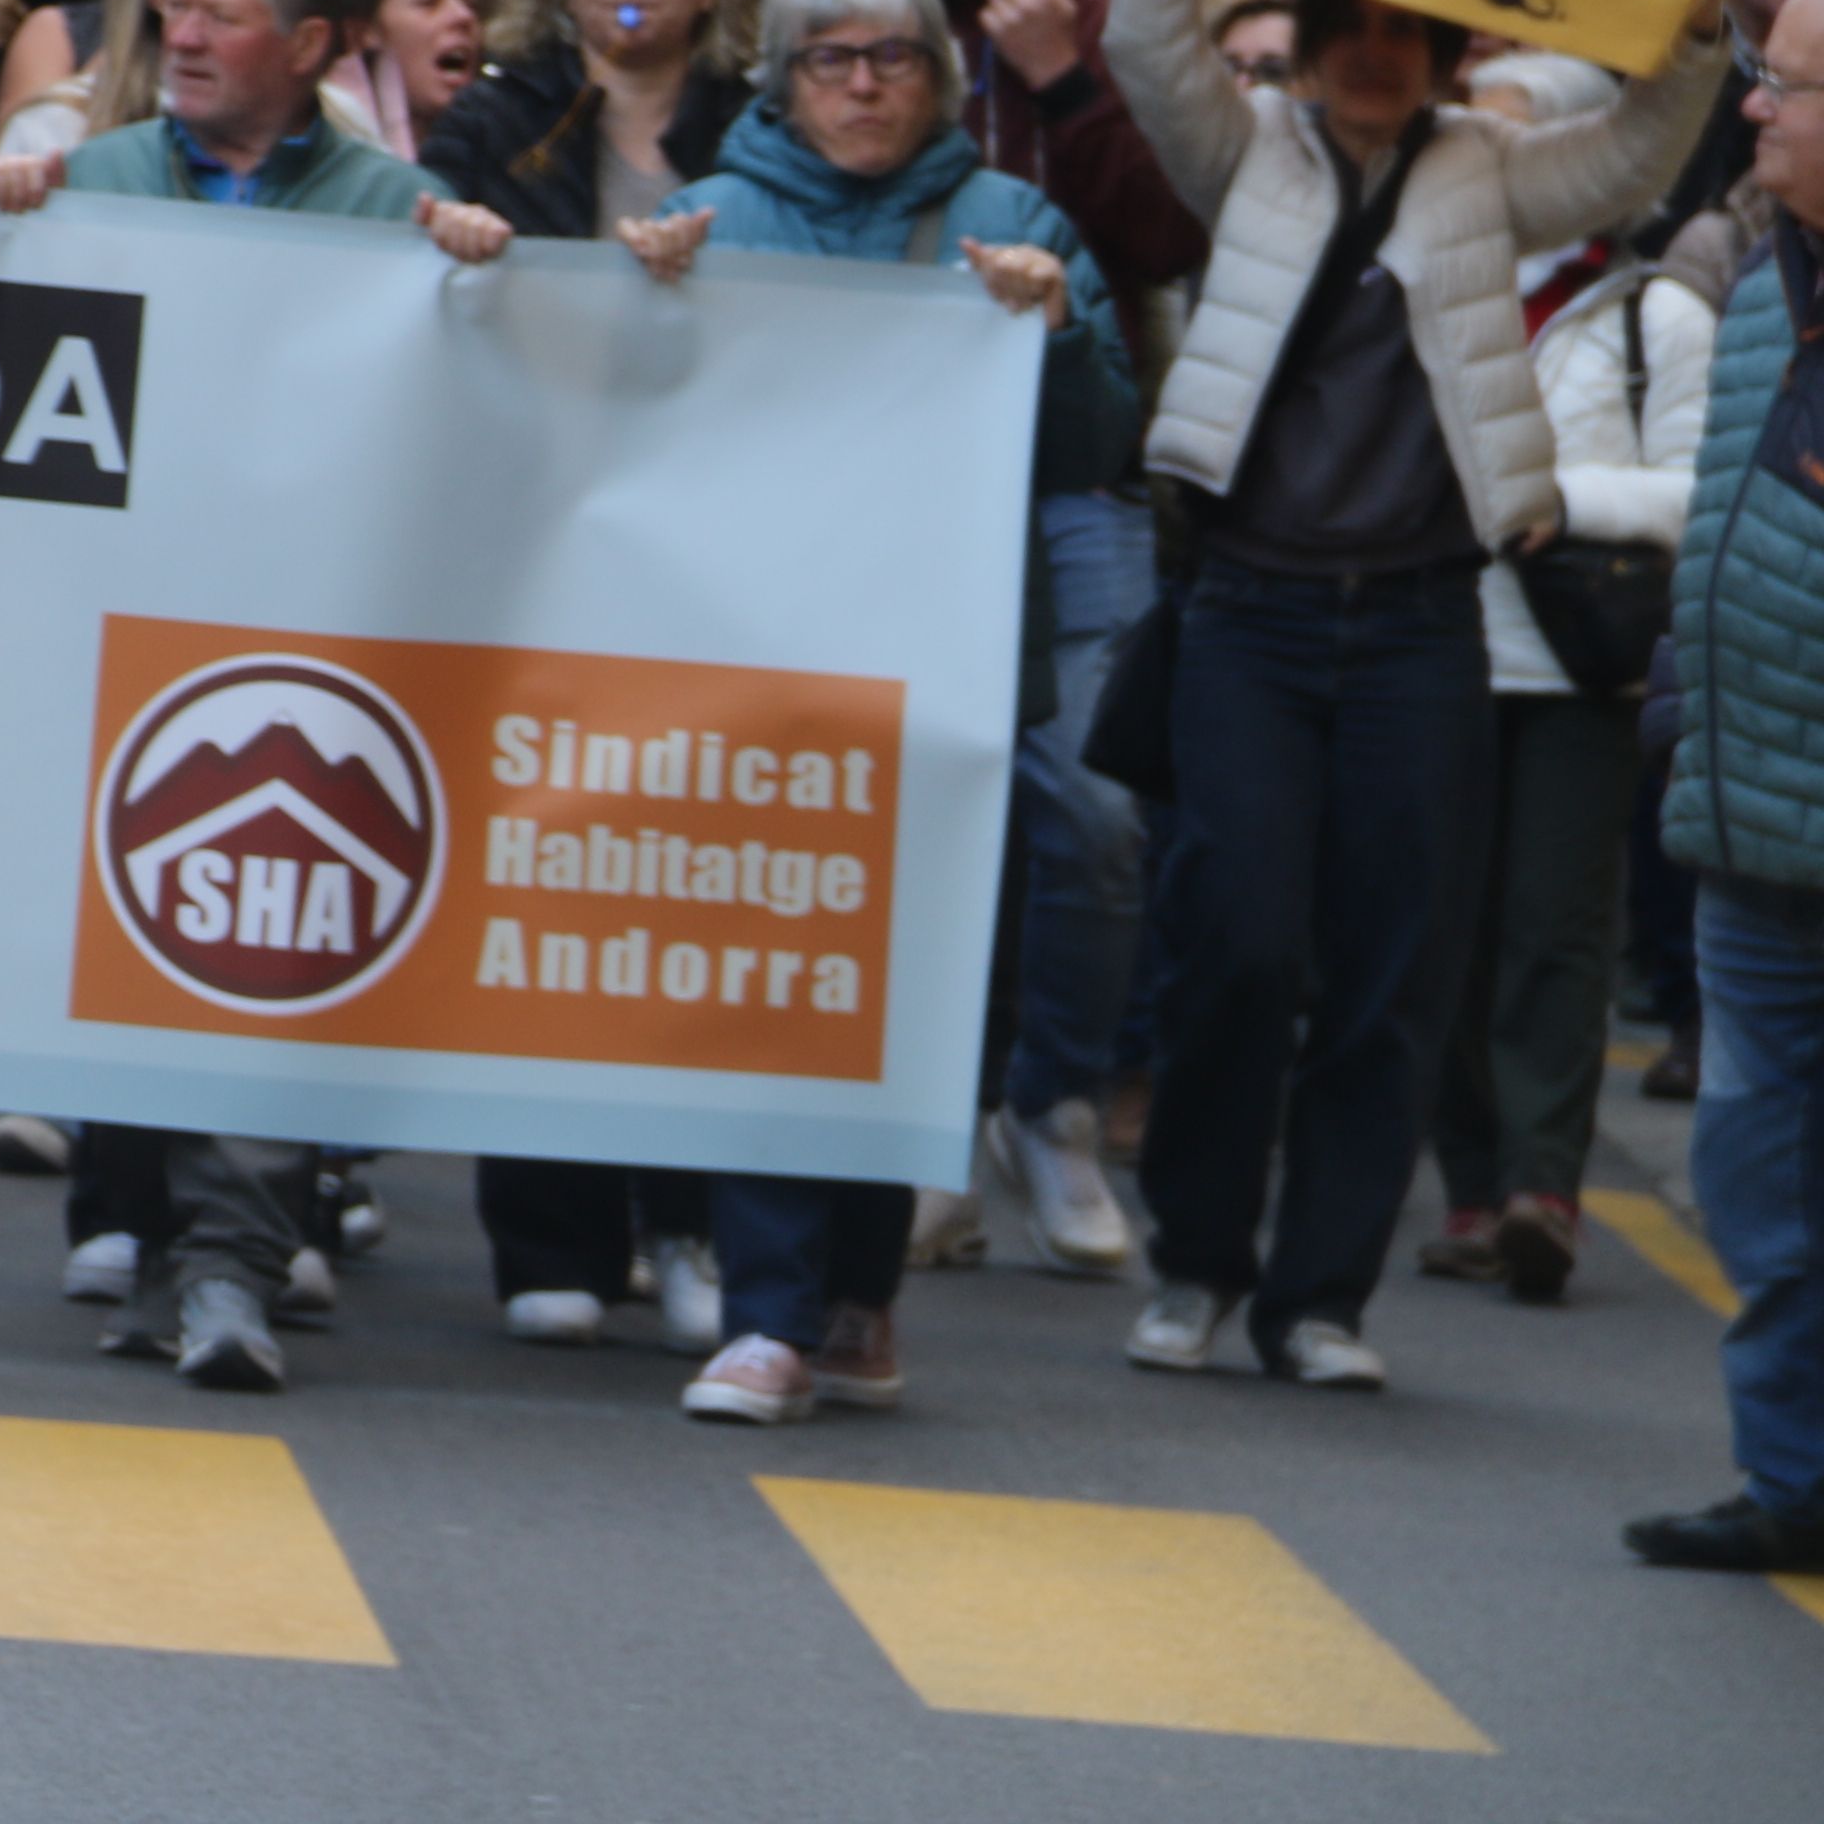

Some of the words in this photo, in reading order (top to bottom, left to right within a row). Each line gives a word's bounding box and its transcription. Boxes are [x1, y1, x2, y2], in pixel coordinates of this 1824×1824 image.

[491, 711, 876, 815] Sindicat
[172, 846, 357, 956] SHA
[483, 816, 868, 918] Habitatge
[474, 916, 861, 1016] Andorra
